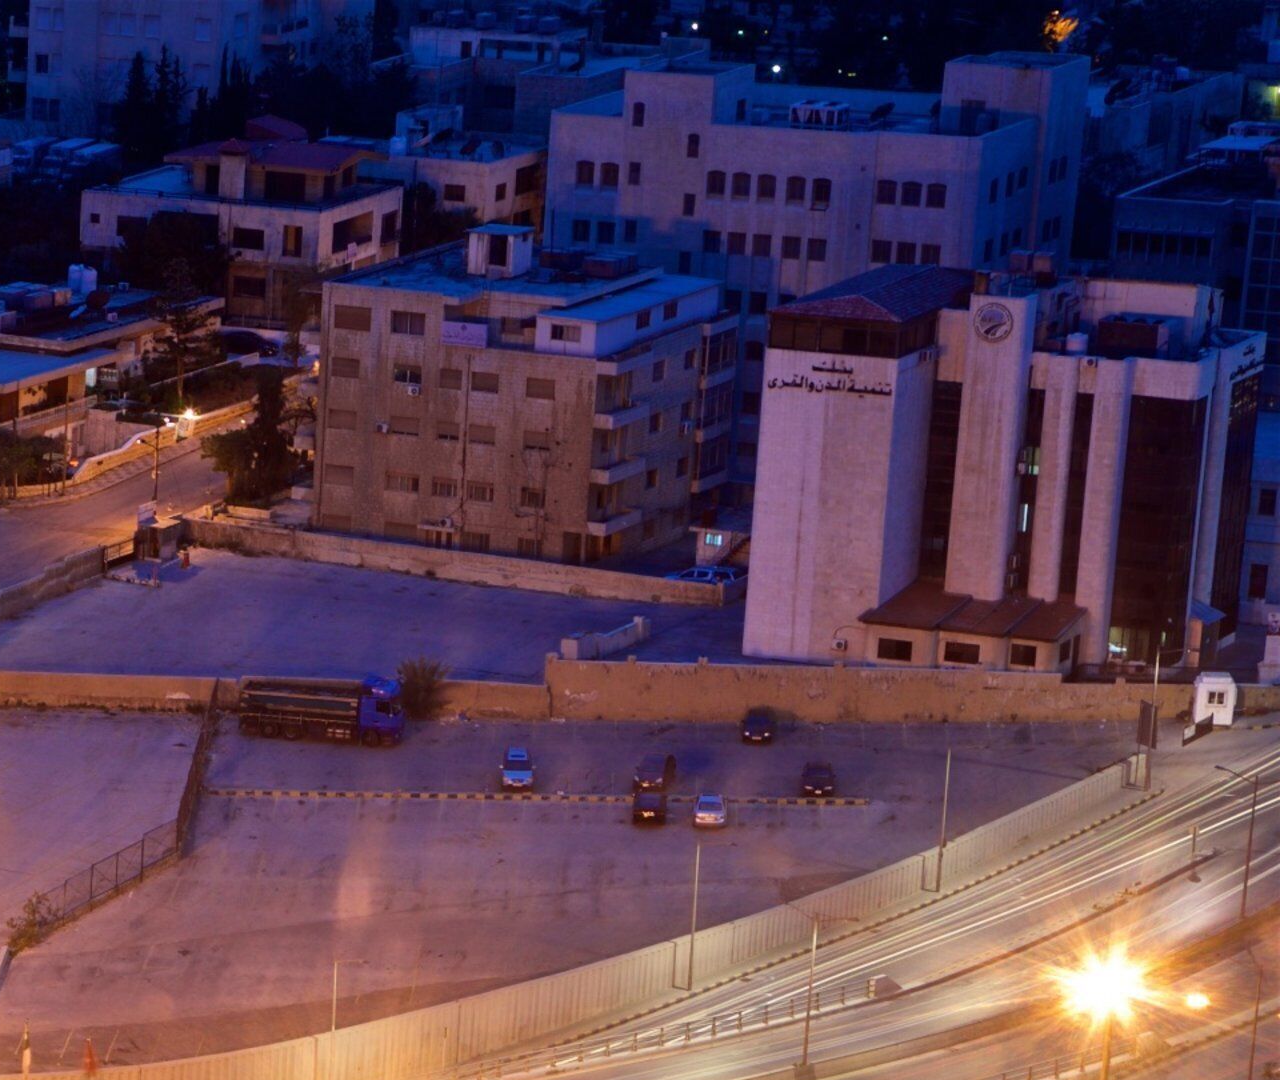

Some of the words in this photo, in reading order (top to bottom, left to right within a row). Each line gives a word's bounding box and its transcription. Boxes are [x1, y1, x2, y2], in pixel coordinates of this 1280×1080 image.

[812, 359, 854, 379] بنك
[768, 374, 814, 393] والقرى
[815, 377, 846, 393] المدن
[846, 379, 893, 398] تنمية
